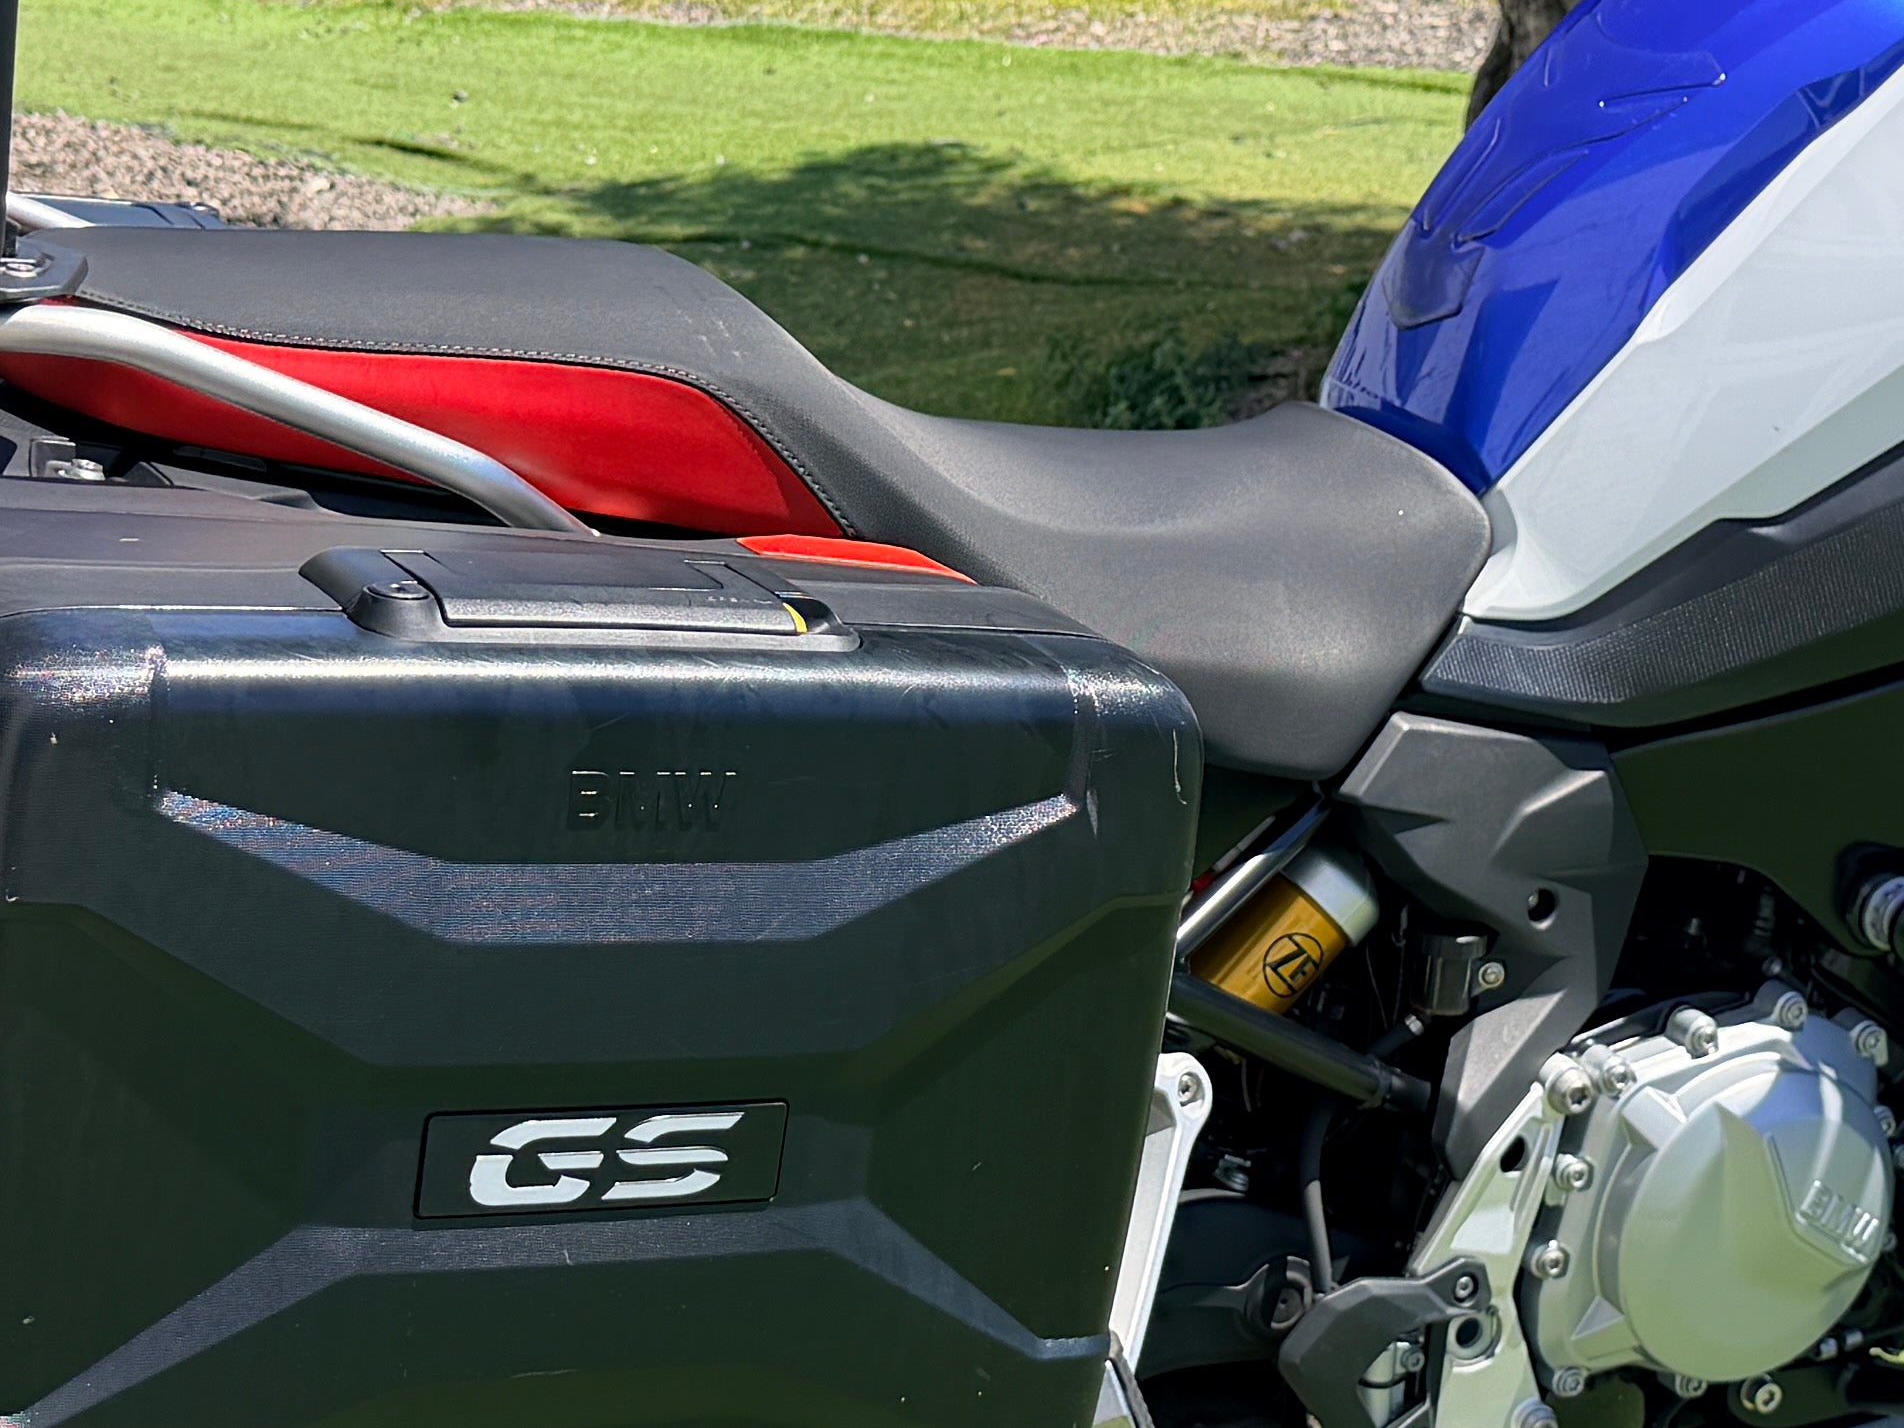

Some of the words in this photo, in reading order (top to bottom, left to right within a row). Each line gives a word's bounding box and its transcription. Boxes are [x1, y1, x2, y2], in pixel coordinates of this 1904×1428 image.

[565, 768, 738, 833] BMW
[469, 1111, 744, 1206] GS
[1797, 1178, 1880, 1248] BMW
